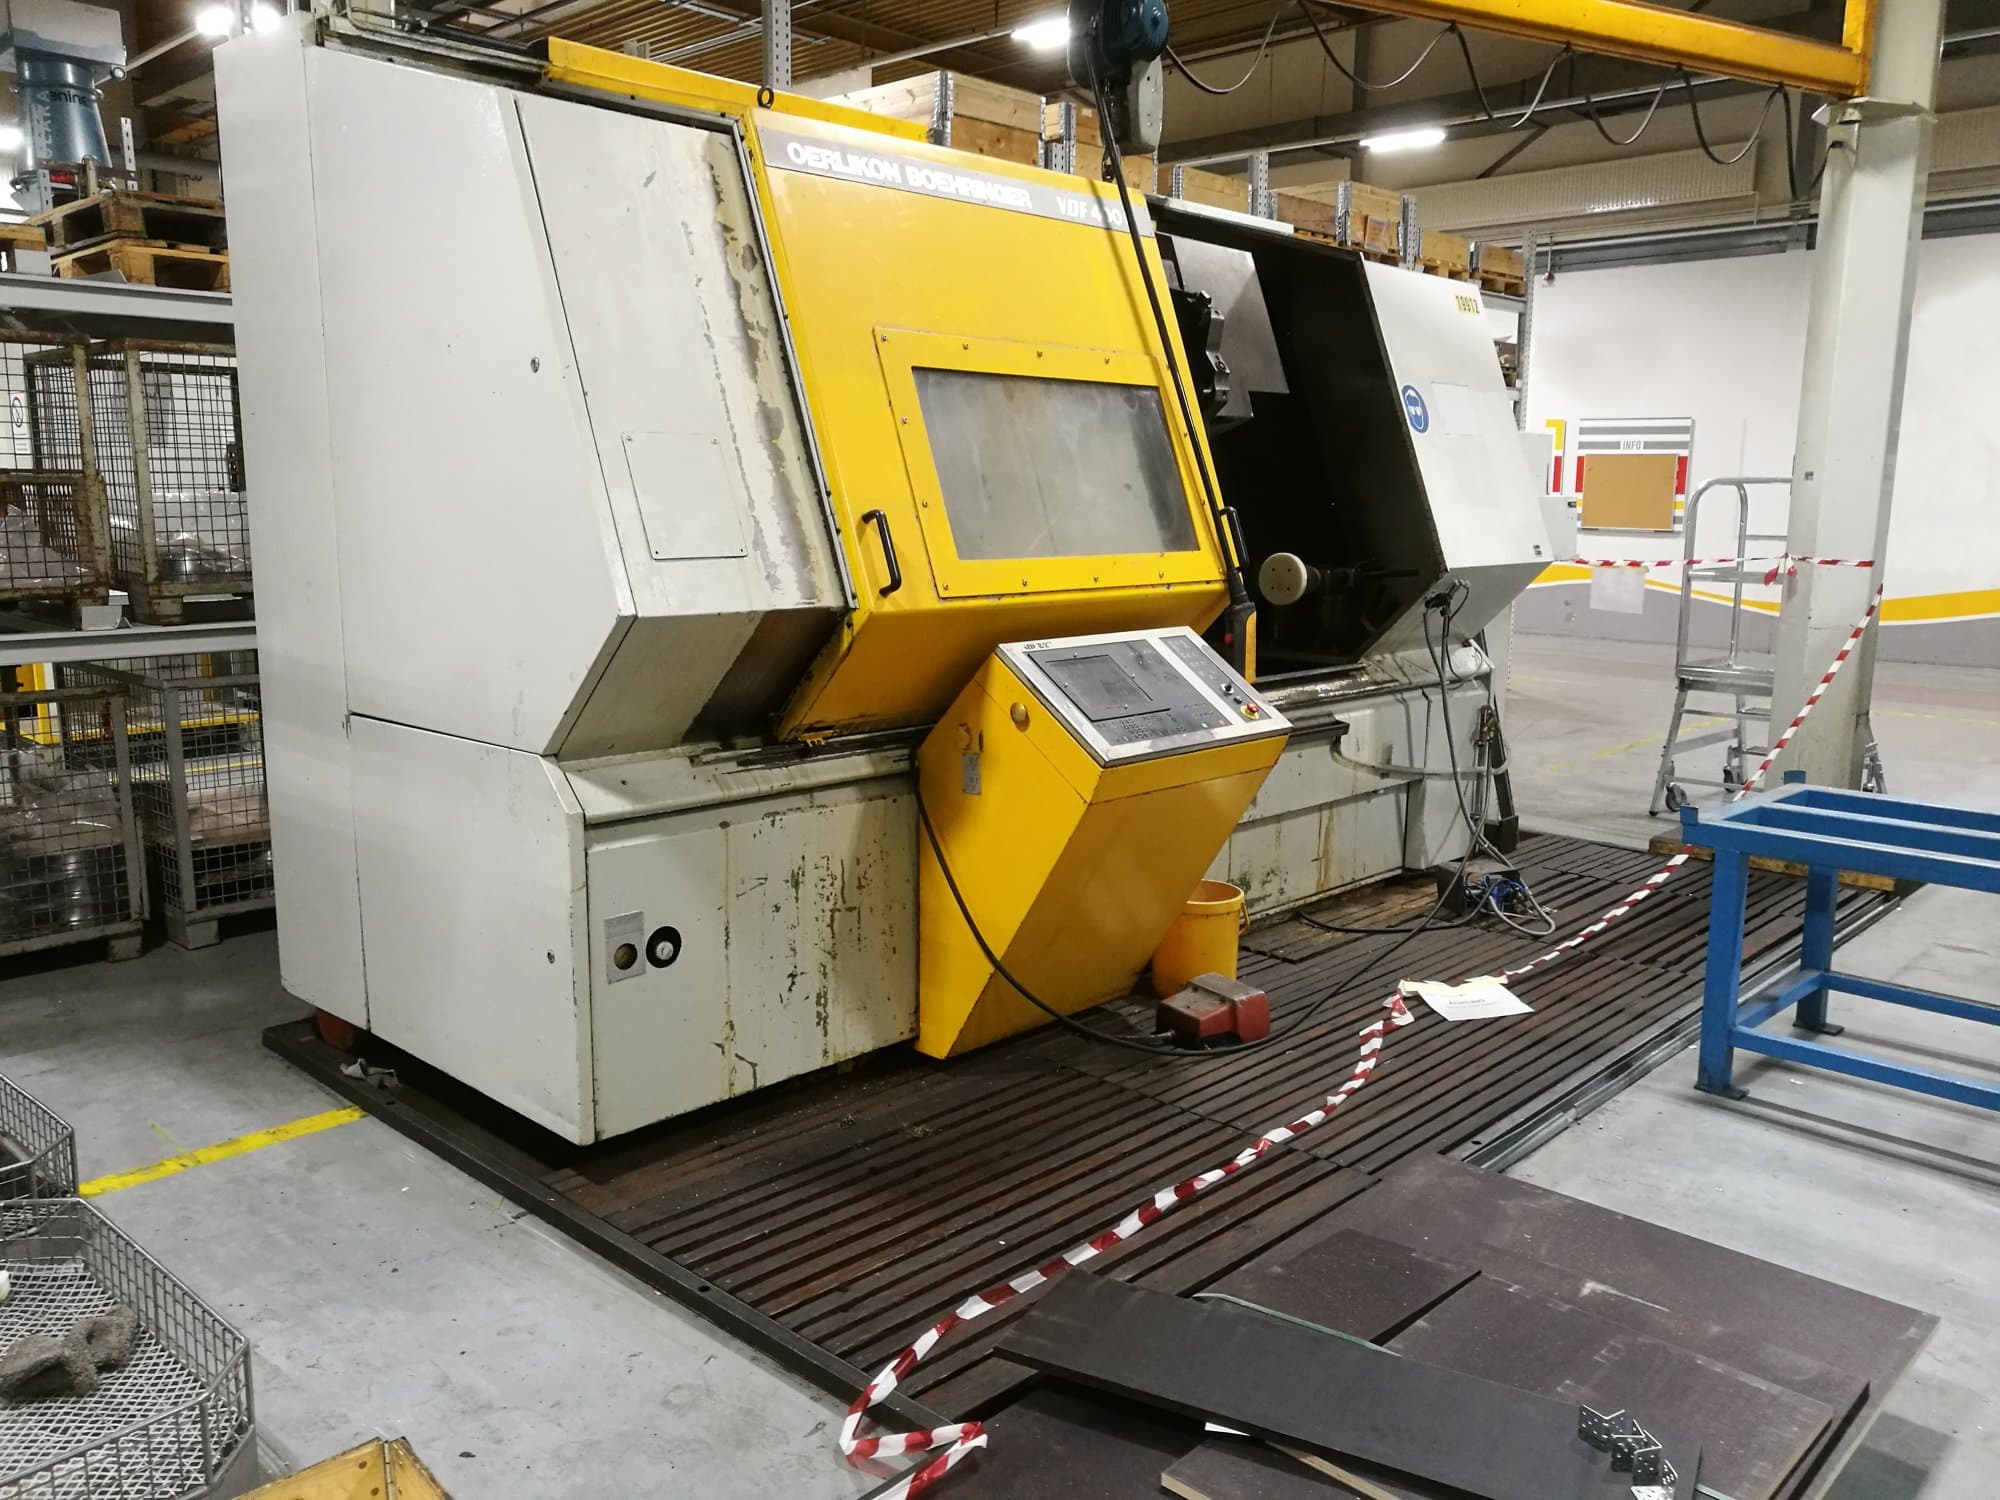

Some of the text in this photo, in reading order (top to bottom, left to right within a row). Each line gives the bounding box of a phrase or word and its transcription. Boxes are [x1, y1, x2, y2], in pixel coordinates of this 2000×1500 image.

[787, 142, 902, 184] OERLIKON
[904, 165, 1033, 209] BOEHRINGER
[1056, 196, 1088, 218] VDF
[1622, 440, 1642, 450] INFO
